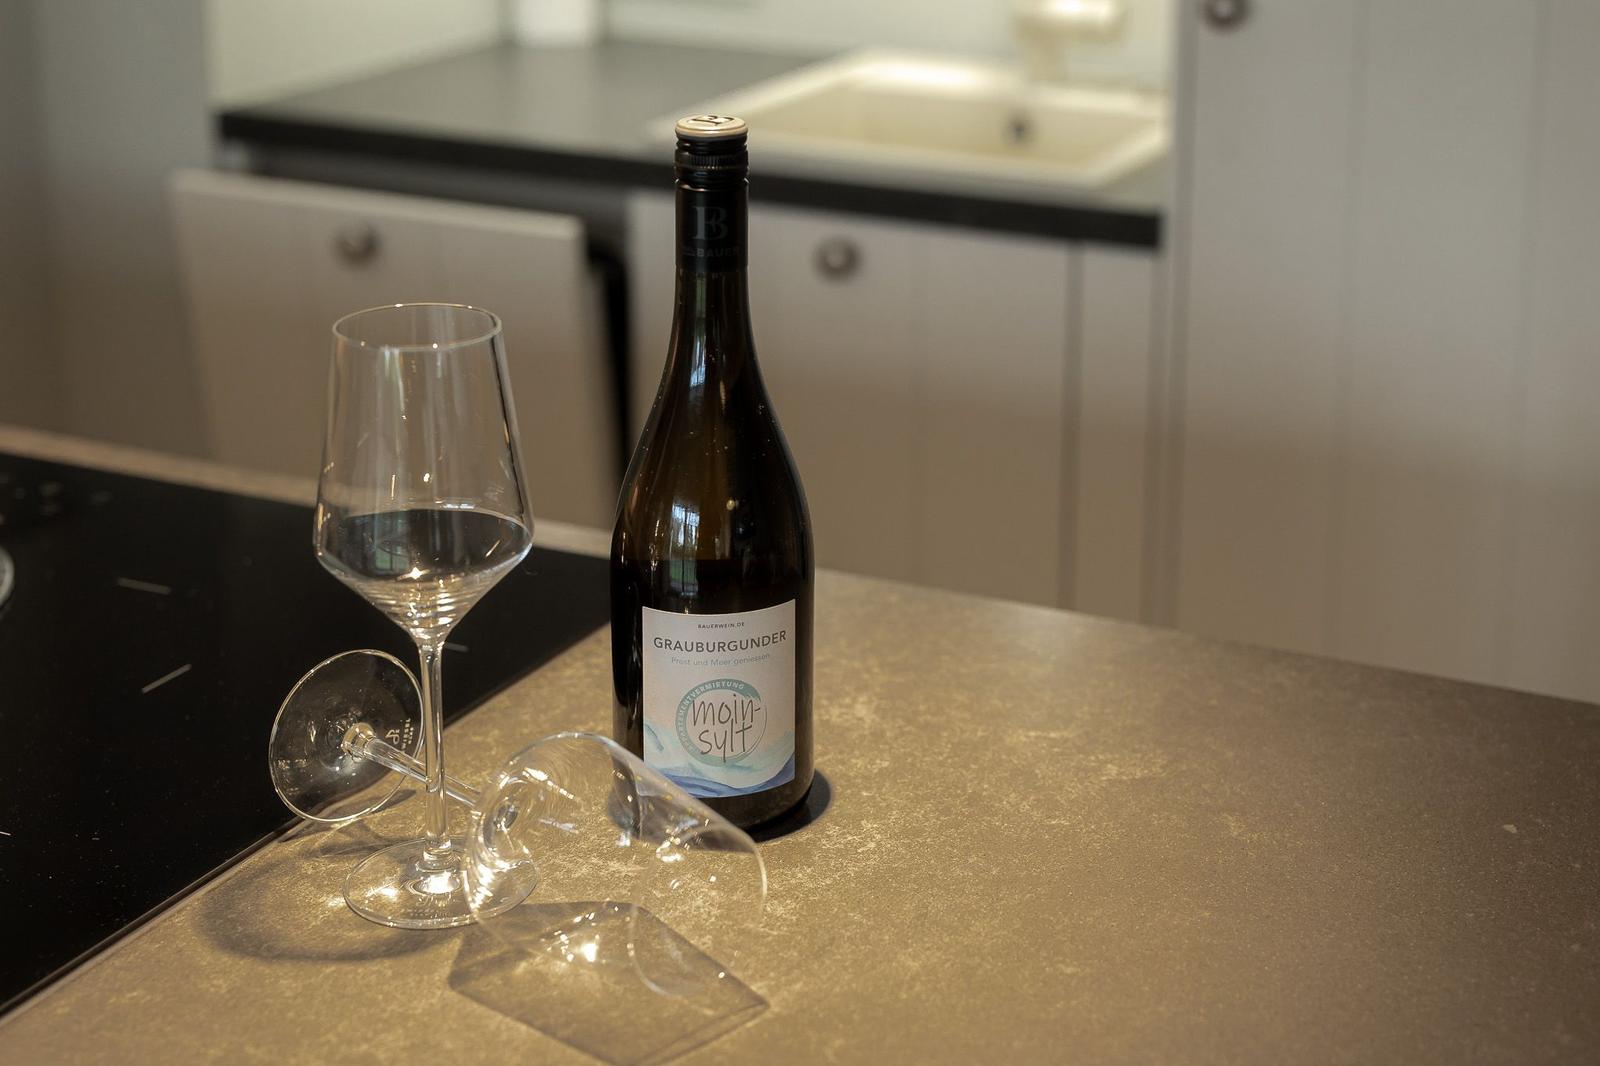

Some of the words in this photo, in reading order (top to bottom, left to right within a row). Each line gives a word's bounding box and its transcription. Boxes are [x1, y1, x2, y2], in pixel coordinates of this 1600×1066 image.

[697, 621, 745, 629] BAUERWEIN.DE
[653, 630, 787, 653] GRAUBURGUNDER
[671, 656, 691, 665] Prost
[694, 657, 709, 666] und
[698, 718, 753, 763] sylt
